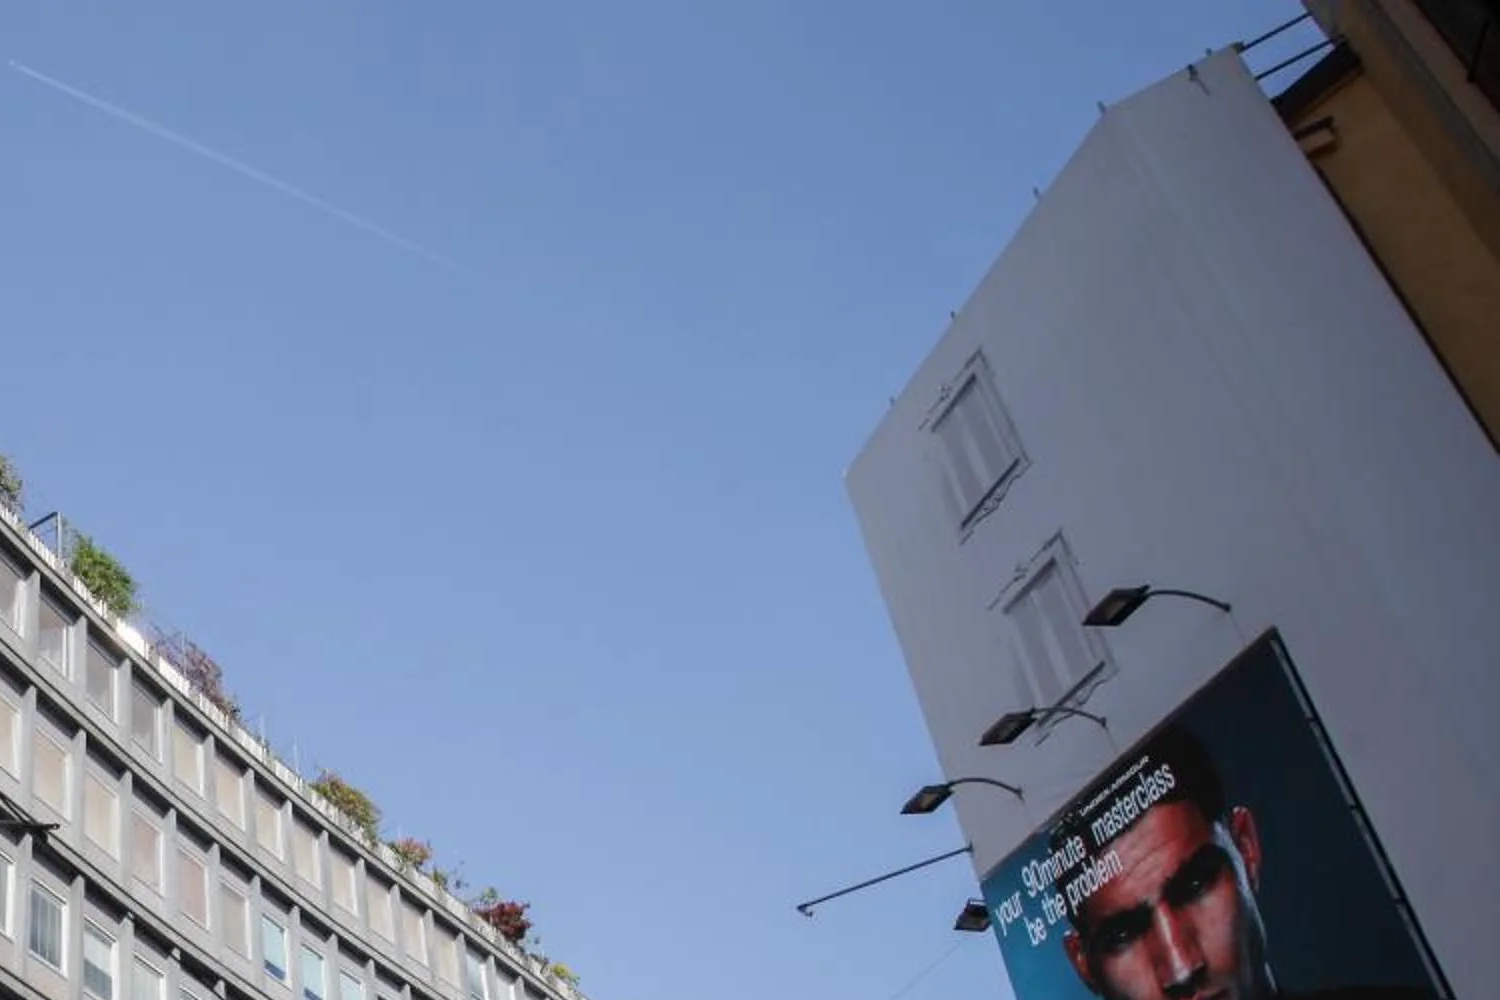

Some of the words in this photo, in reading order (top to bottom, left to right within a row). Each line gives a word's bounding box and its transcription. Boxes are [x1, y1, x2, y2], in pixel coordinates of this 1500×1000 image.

[995, 890, 1024, 936] your
[1022, 834, 1086, 897] 90minute
[1091, 763, 1176, 845] masterclass
[1024, 915, 1047, 946] be
[1041, 892, 1068, 924] the
[1065, 849, 1124, 916] problem
